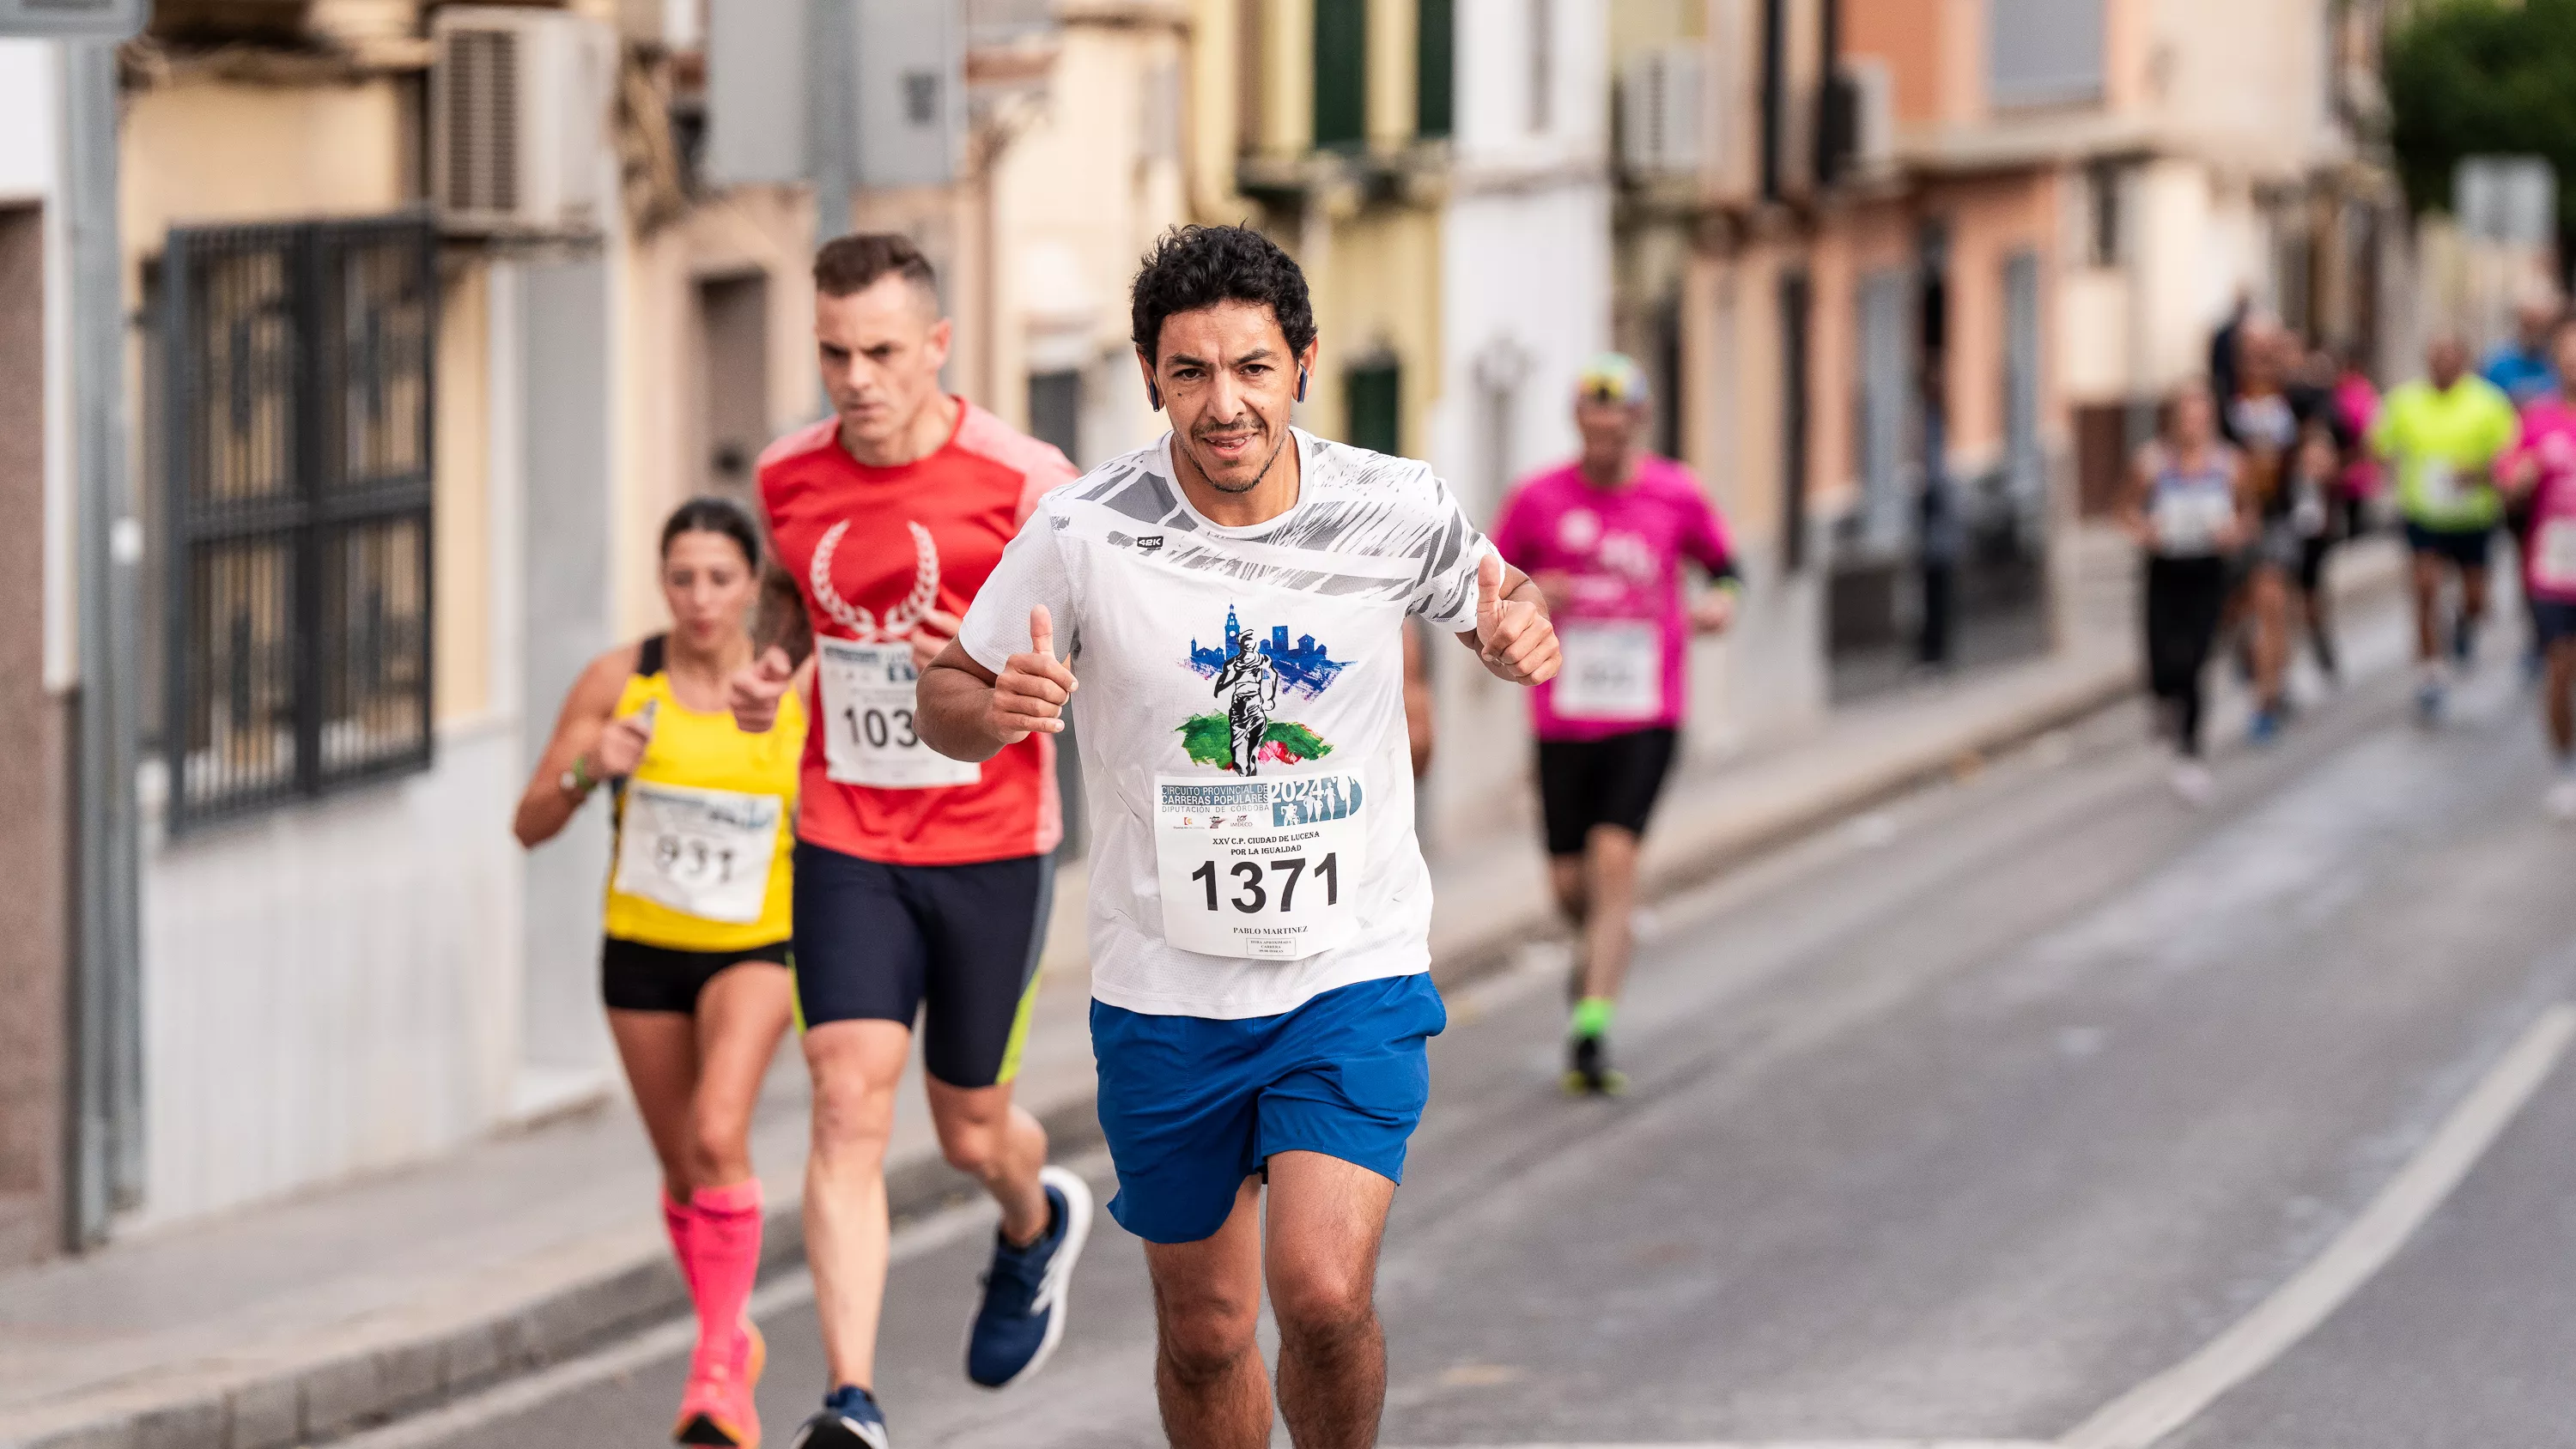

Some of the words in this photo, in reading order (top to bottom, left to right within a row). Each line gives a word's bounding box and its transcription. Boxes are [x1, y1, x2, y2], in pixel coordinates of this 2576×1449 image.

[1138, 537, 1162, 546] 42K
[843, 706, 919, 749] 103
[1162, 785, 1200, 796] CIRCUITO
[1203, 785, 1255, 796] PROVINCIAL
[1257, 784, 1268, 794] DE
[1271, 778, 1324, 803] 2024
[1162, 795, 1211, 805] CARRERAS
[1214, 793, 1268, 805] POPULARES
[1162, 804, 1211, 813] DIPUTACIÓN
[1291, 831, 1321, 841] LUCENA
[1261, 845, 1302, 855] IGUALDAD
[1192, 852, 1338, 914] 1371
[1263, 925, 1309, 935] MARTINEZ
